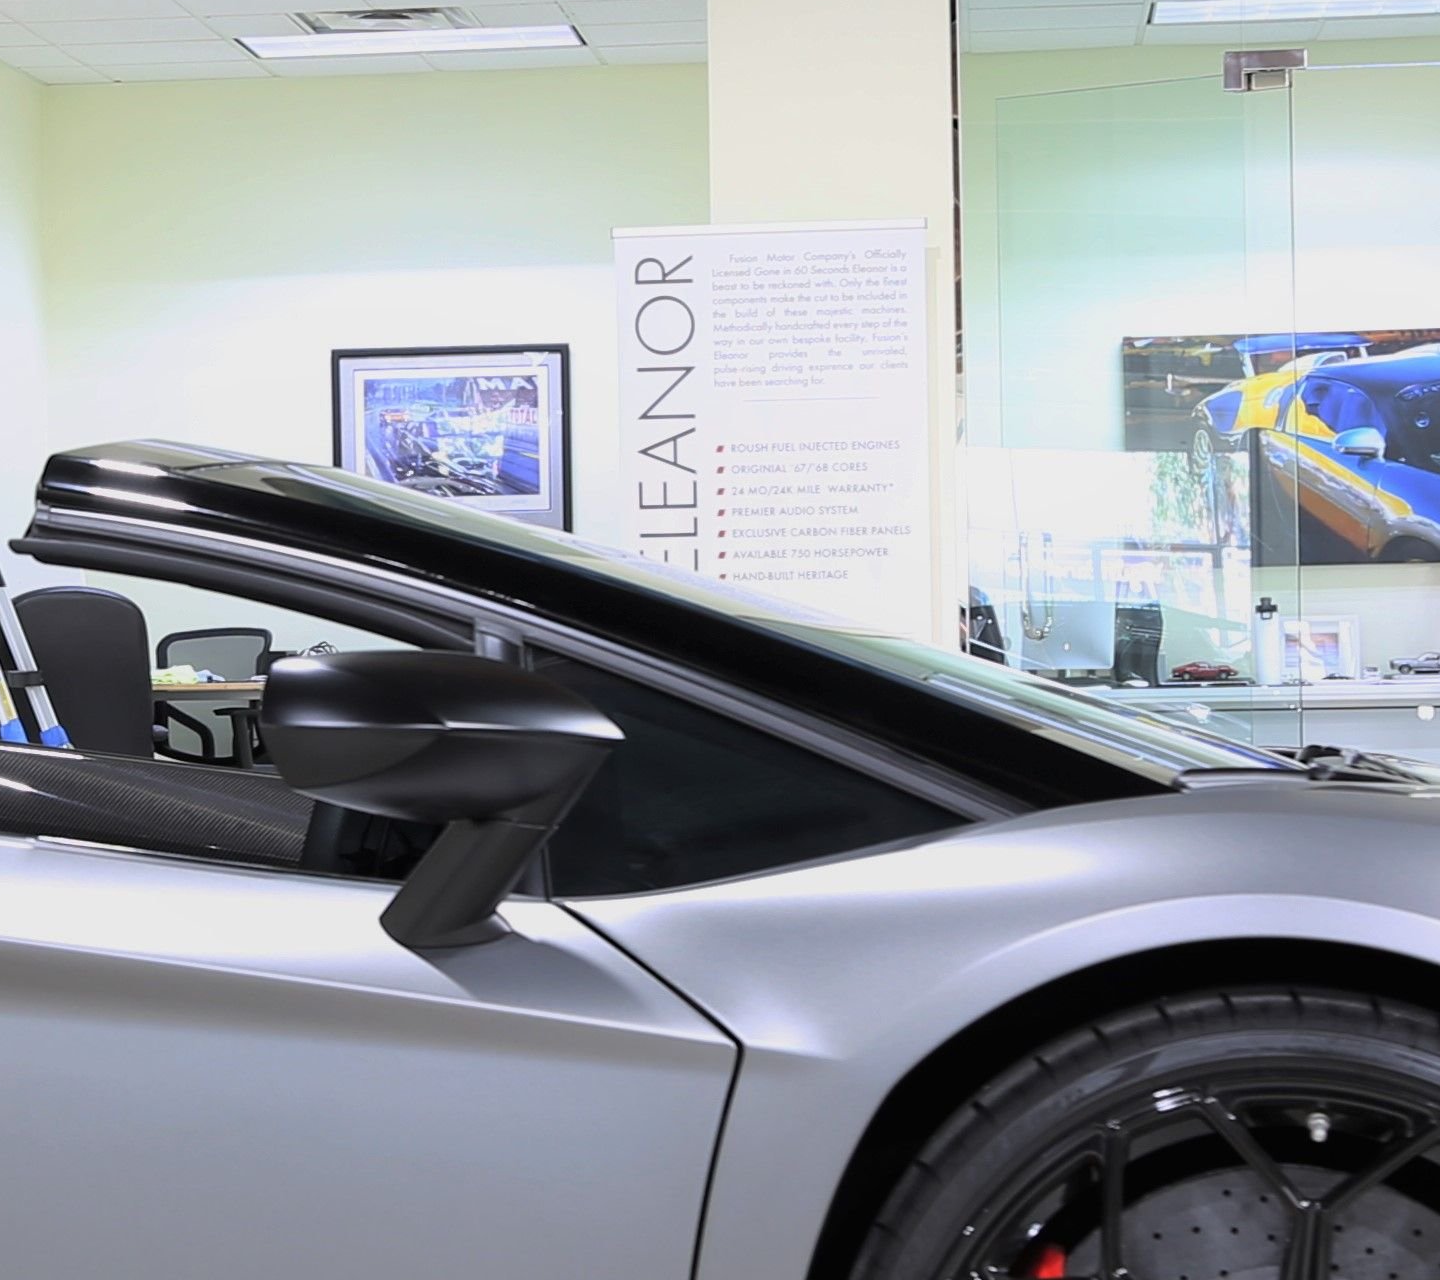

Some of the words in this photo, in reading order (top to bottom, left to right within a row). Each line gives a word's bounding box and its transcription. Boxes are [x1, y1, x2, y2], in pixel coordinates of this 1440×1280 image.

[477, 377, 538, 390] MA
[731, 443, 768, 453] ROUSH
[771, 442, 796, 452] FUEL
[799, 441, 848, 451] INJECTED
[851, 440, 900, 450] ENGINES
[832, 462, 868, 471] CORES
[732, 487, 744, 496] 24
[748, 486, 793, 496] MO/24K
[797, 485, 821, 494] MILE
[732, 508, 775, 516] PREMIER
[779, 506, 815, 515] AUDIO
[818, 506, 859, 515] SYSTEM
[732, 529, 787, 538] EXCLUSIVE
[790, 527, 837, 537] CARBON
[840, 527, 868, 536] FIBER
[871, 526, 911, 535] PANELS
[732, 549, 788, 559] AVAILABLE
[791, 549, 811, 558] 750
[814, 548, 889, 558] HORSEPOWER
[733, 572, 795, 581] HAND-BUILT
[798, 570, 848, 579] HERITAGE
